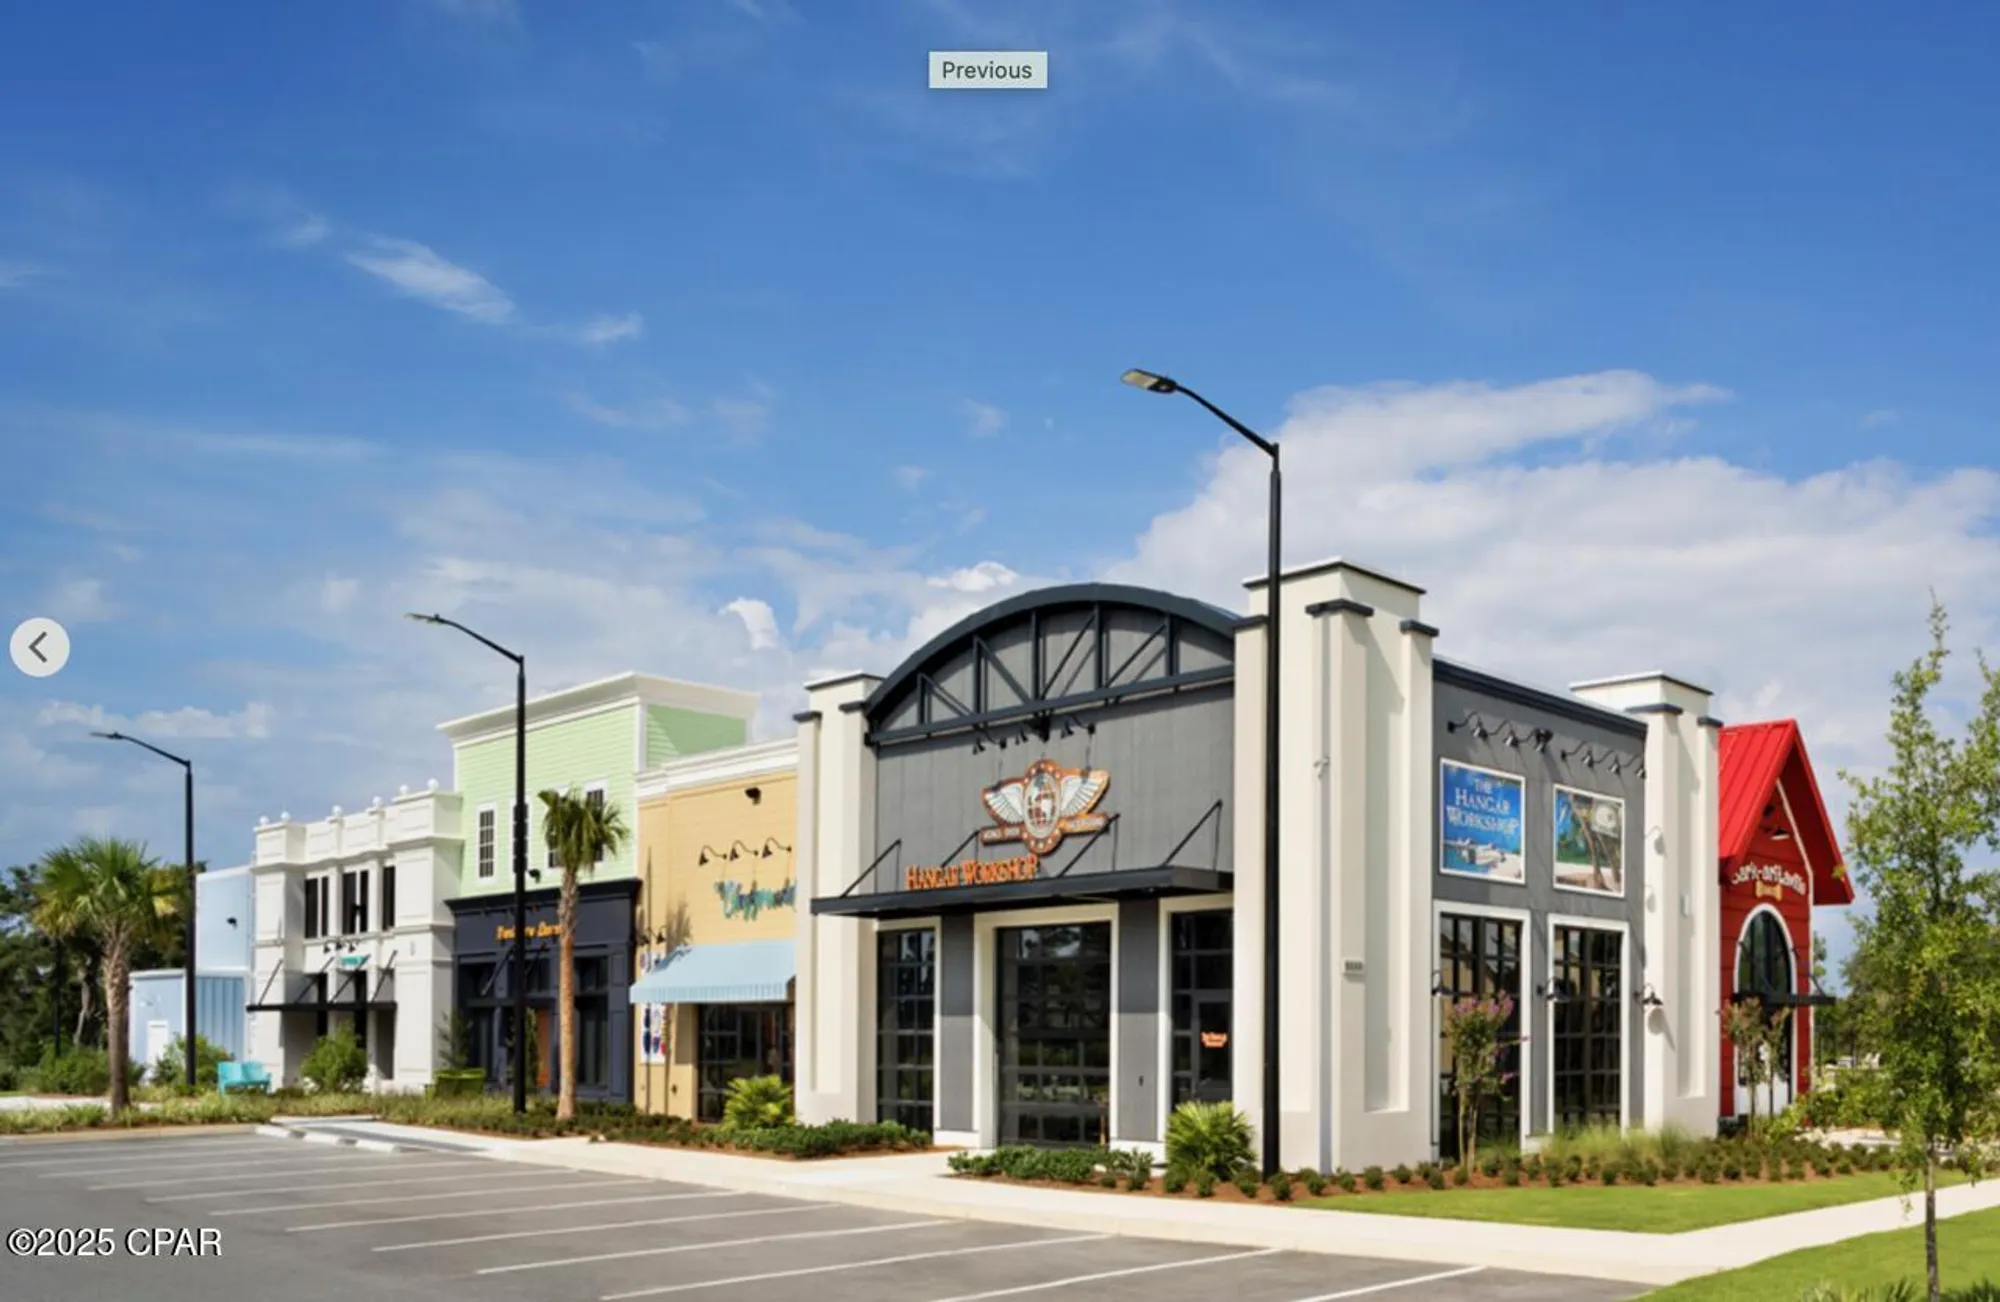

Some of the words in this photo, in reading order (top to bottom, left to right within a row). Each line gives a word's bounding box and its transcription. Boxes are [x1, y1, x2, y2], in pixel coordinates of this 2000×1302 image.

[1454, 787, 1511, 815] HANGAR
[1474, 778, 1493, 795] THE
[1445, 805, 1520, 835] WORKSHOP
[960, 852, 1038, 886] WORKSHOP
